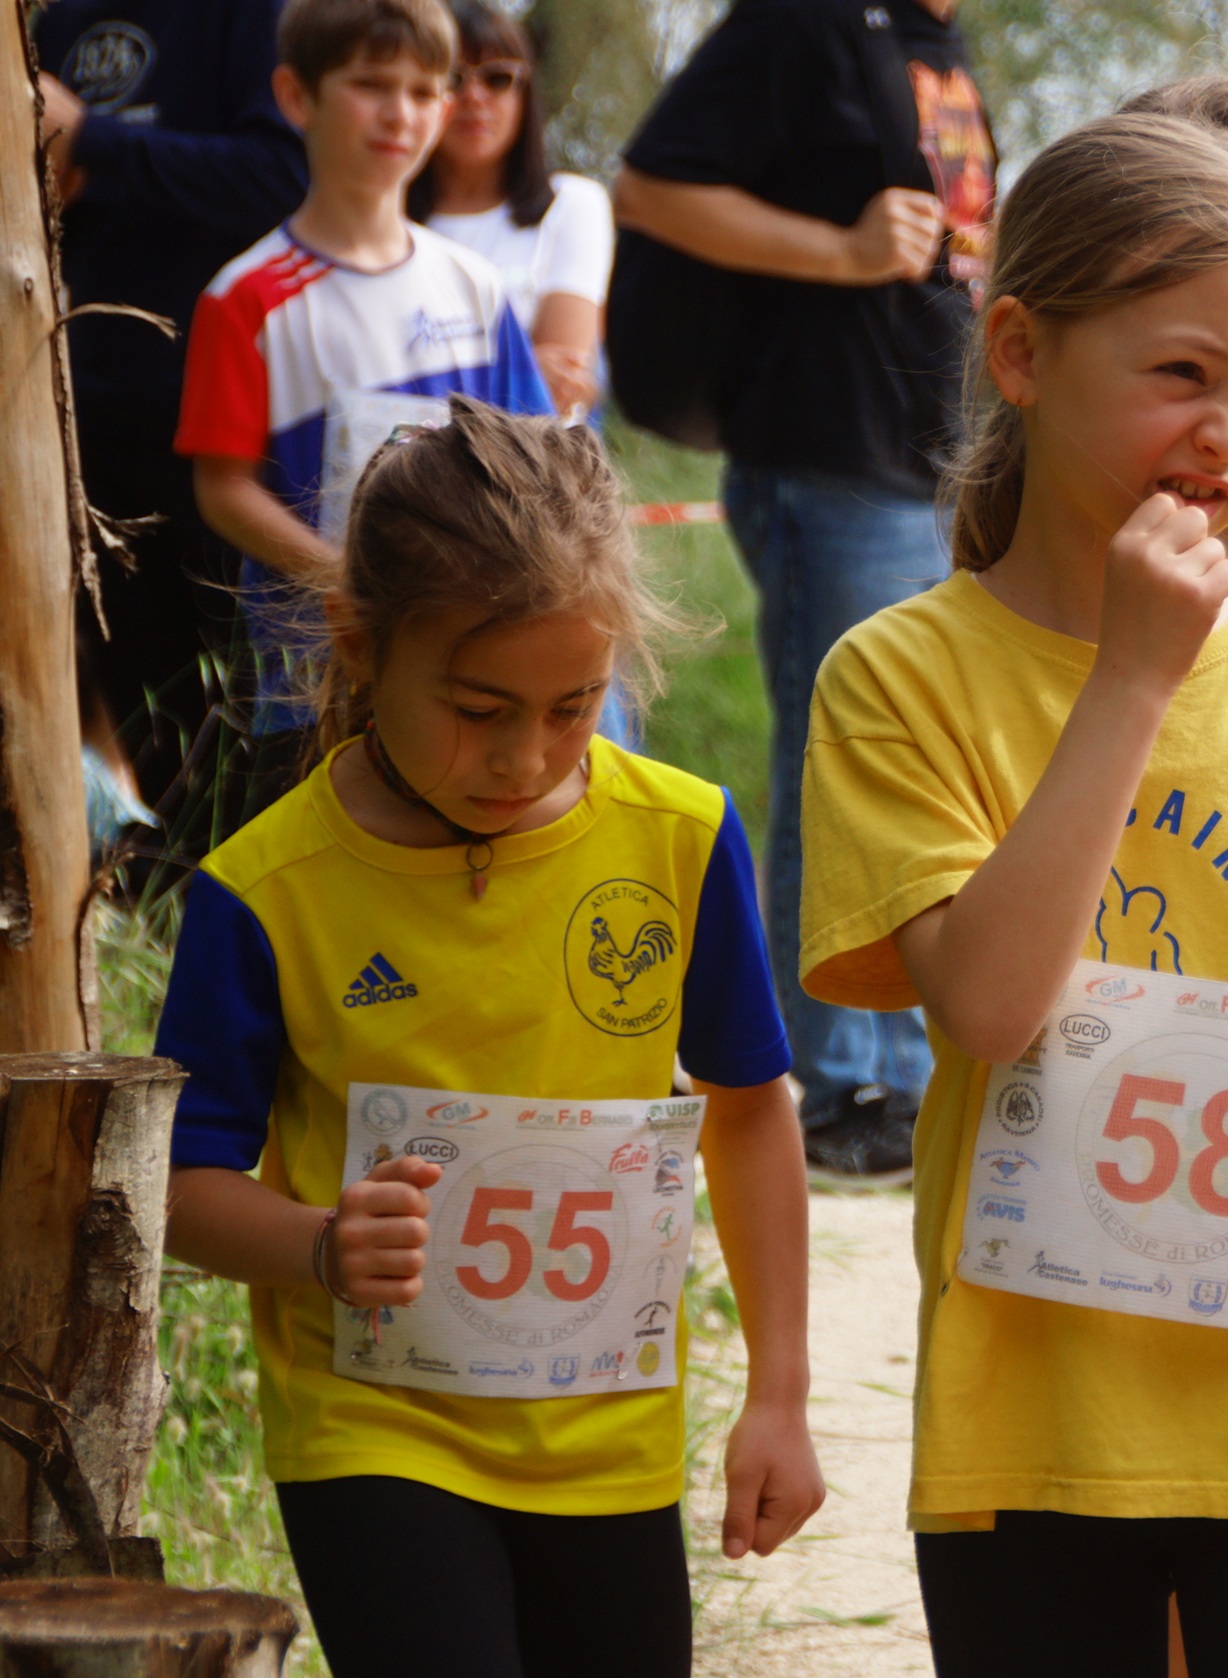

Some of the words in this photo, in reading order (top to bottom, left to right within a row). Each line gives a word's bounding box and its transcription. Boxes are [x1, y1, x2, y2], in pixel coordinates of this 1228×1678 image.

[591, 887, 649, 911] ATLETICA
[342, 981, 418, 1009] adidas
[1100, 978, 1127, 997] GM
[596, 1007, 618, 1027] SAN
[621, 997, 668, 1029] PATRIZIO
[1063, 1020, 1106, 1040] LUCCI
[442, 1102, 471, 1120] GM
[666, 1102, 700, 1118] UISP
[409, 1144, 454, 1158] LUCCI
[455, 1187, 613, 1302] 55
[1039, 1270, 1088, 1286] Castenaso
[1041, 1262, 1080, 1276] Atletica
